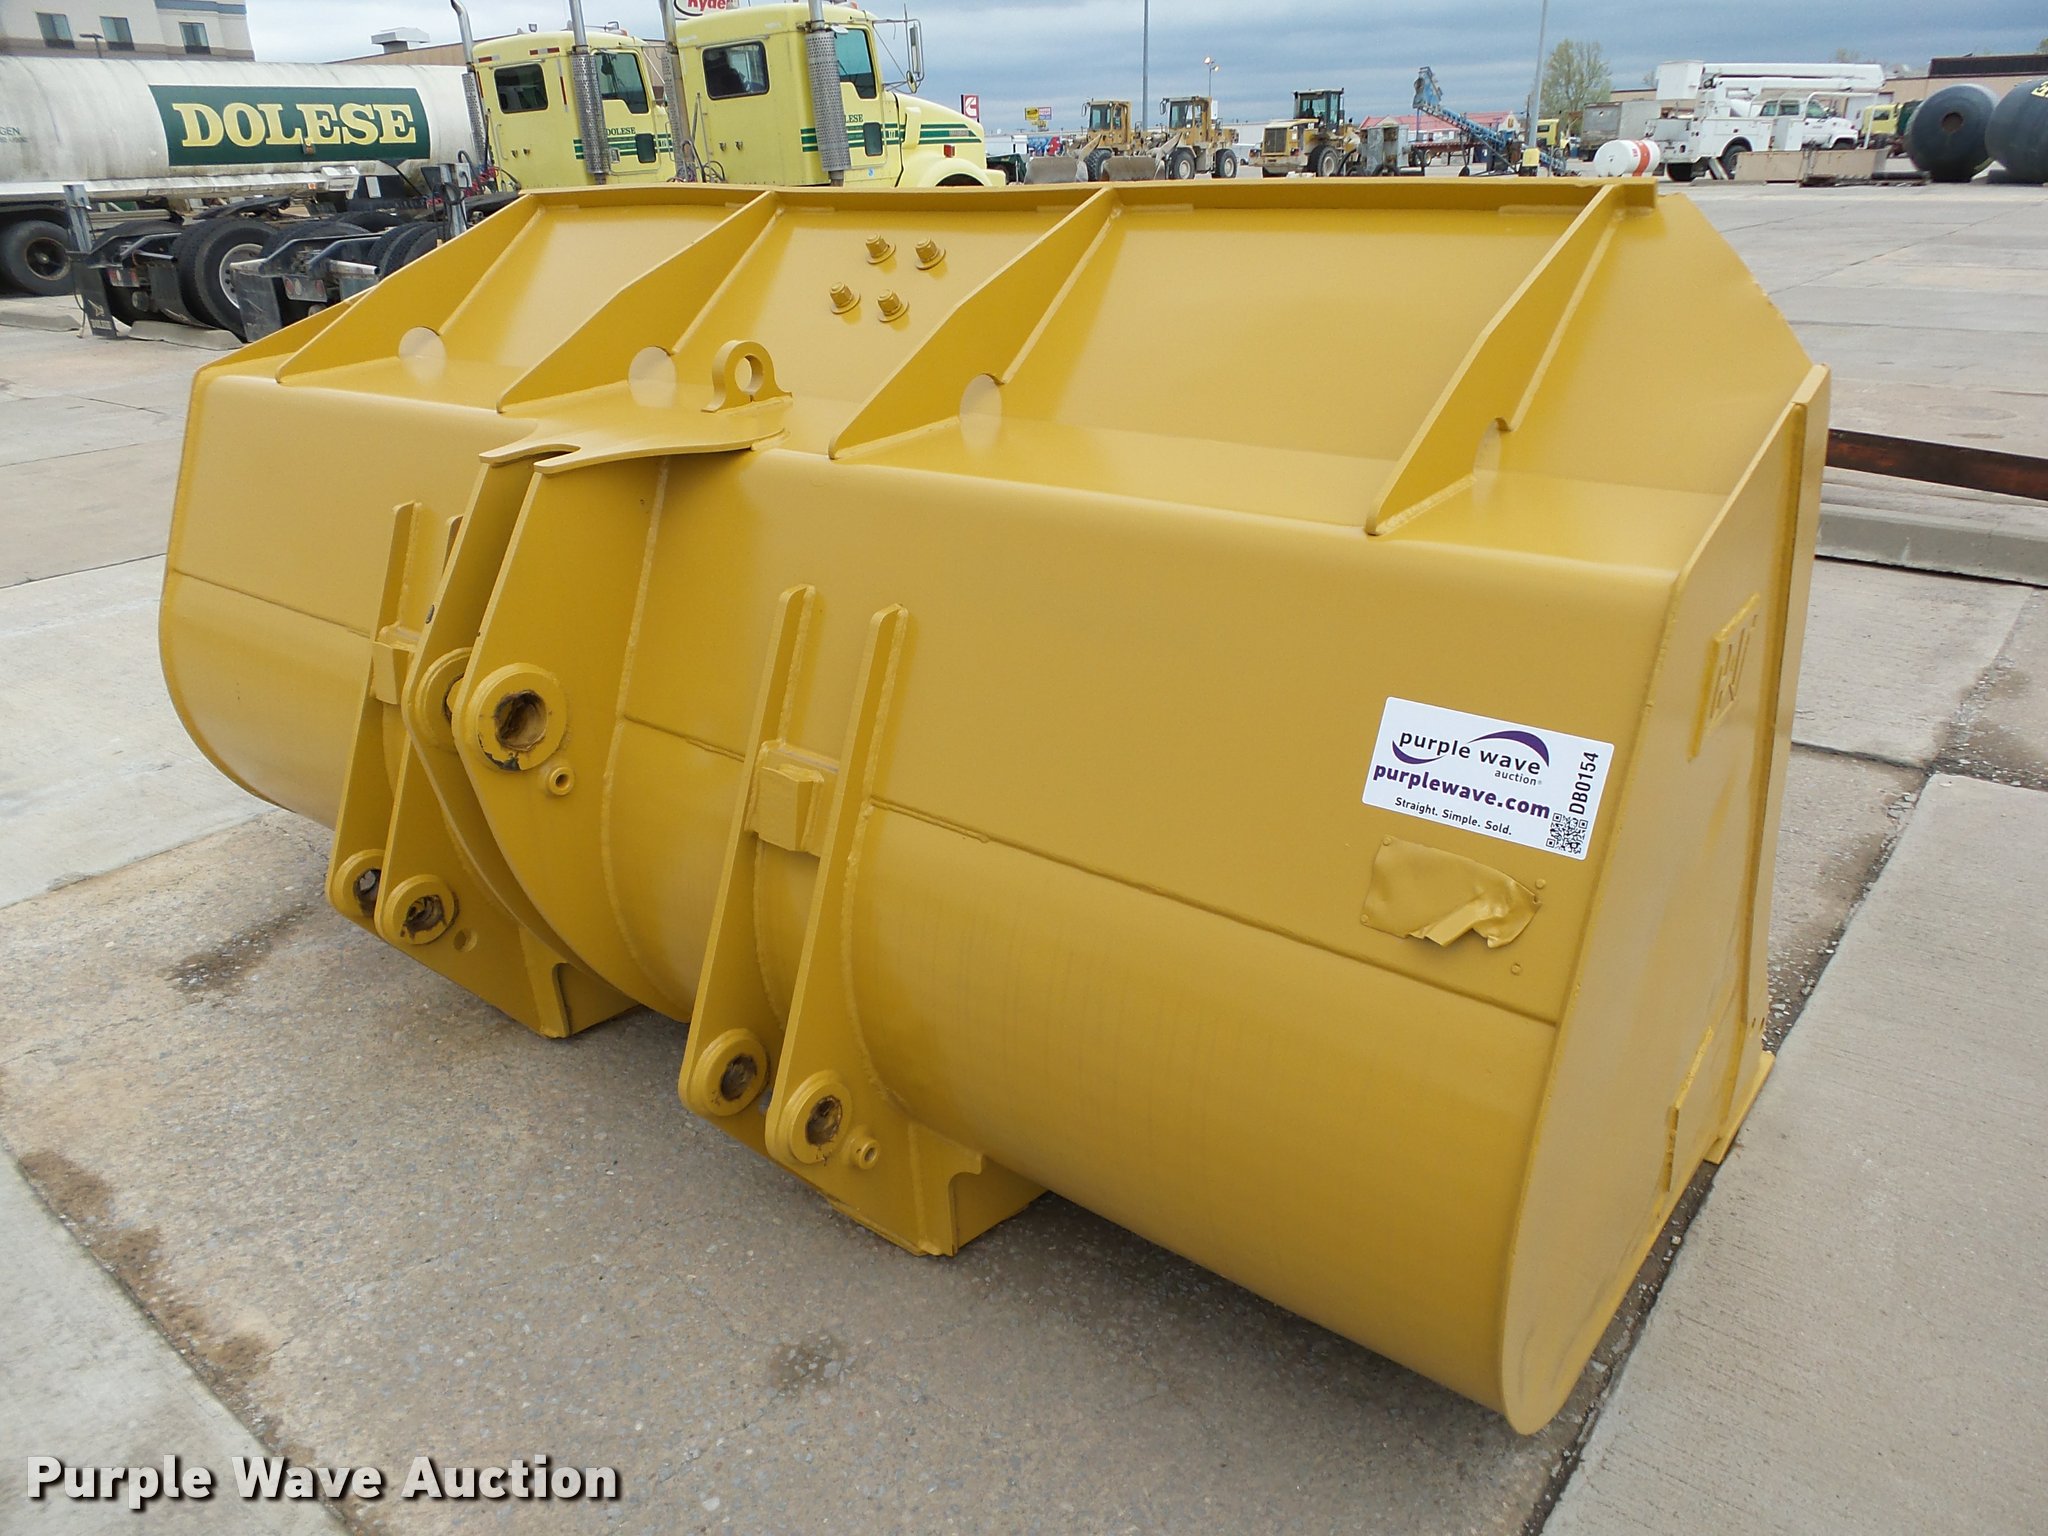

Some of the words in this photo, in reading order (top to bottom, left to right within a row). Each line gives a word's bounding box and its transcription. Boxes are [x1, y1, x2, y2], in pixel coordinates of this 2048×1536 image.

[172, 102, 417, 147] DOLESE
[844, 114, 864, 123] LESE
[1399, 731, 1471, 759] purple
[1480, 749, 1541, 775] wave
[1373, 764, 1550, 819] purplewave.com
[1494, 769, 1537, 786] auction
[1568, 751, 1599, 815] DB0154
[1394, 797, 1438, 816] Straight.
[1442, 809, 1481, 828] Simple.
[1484, 820, 1512, 836] Sold.
